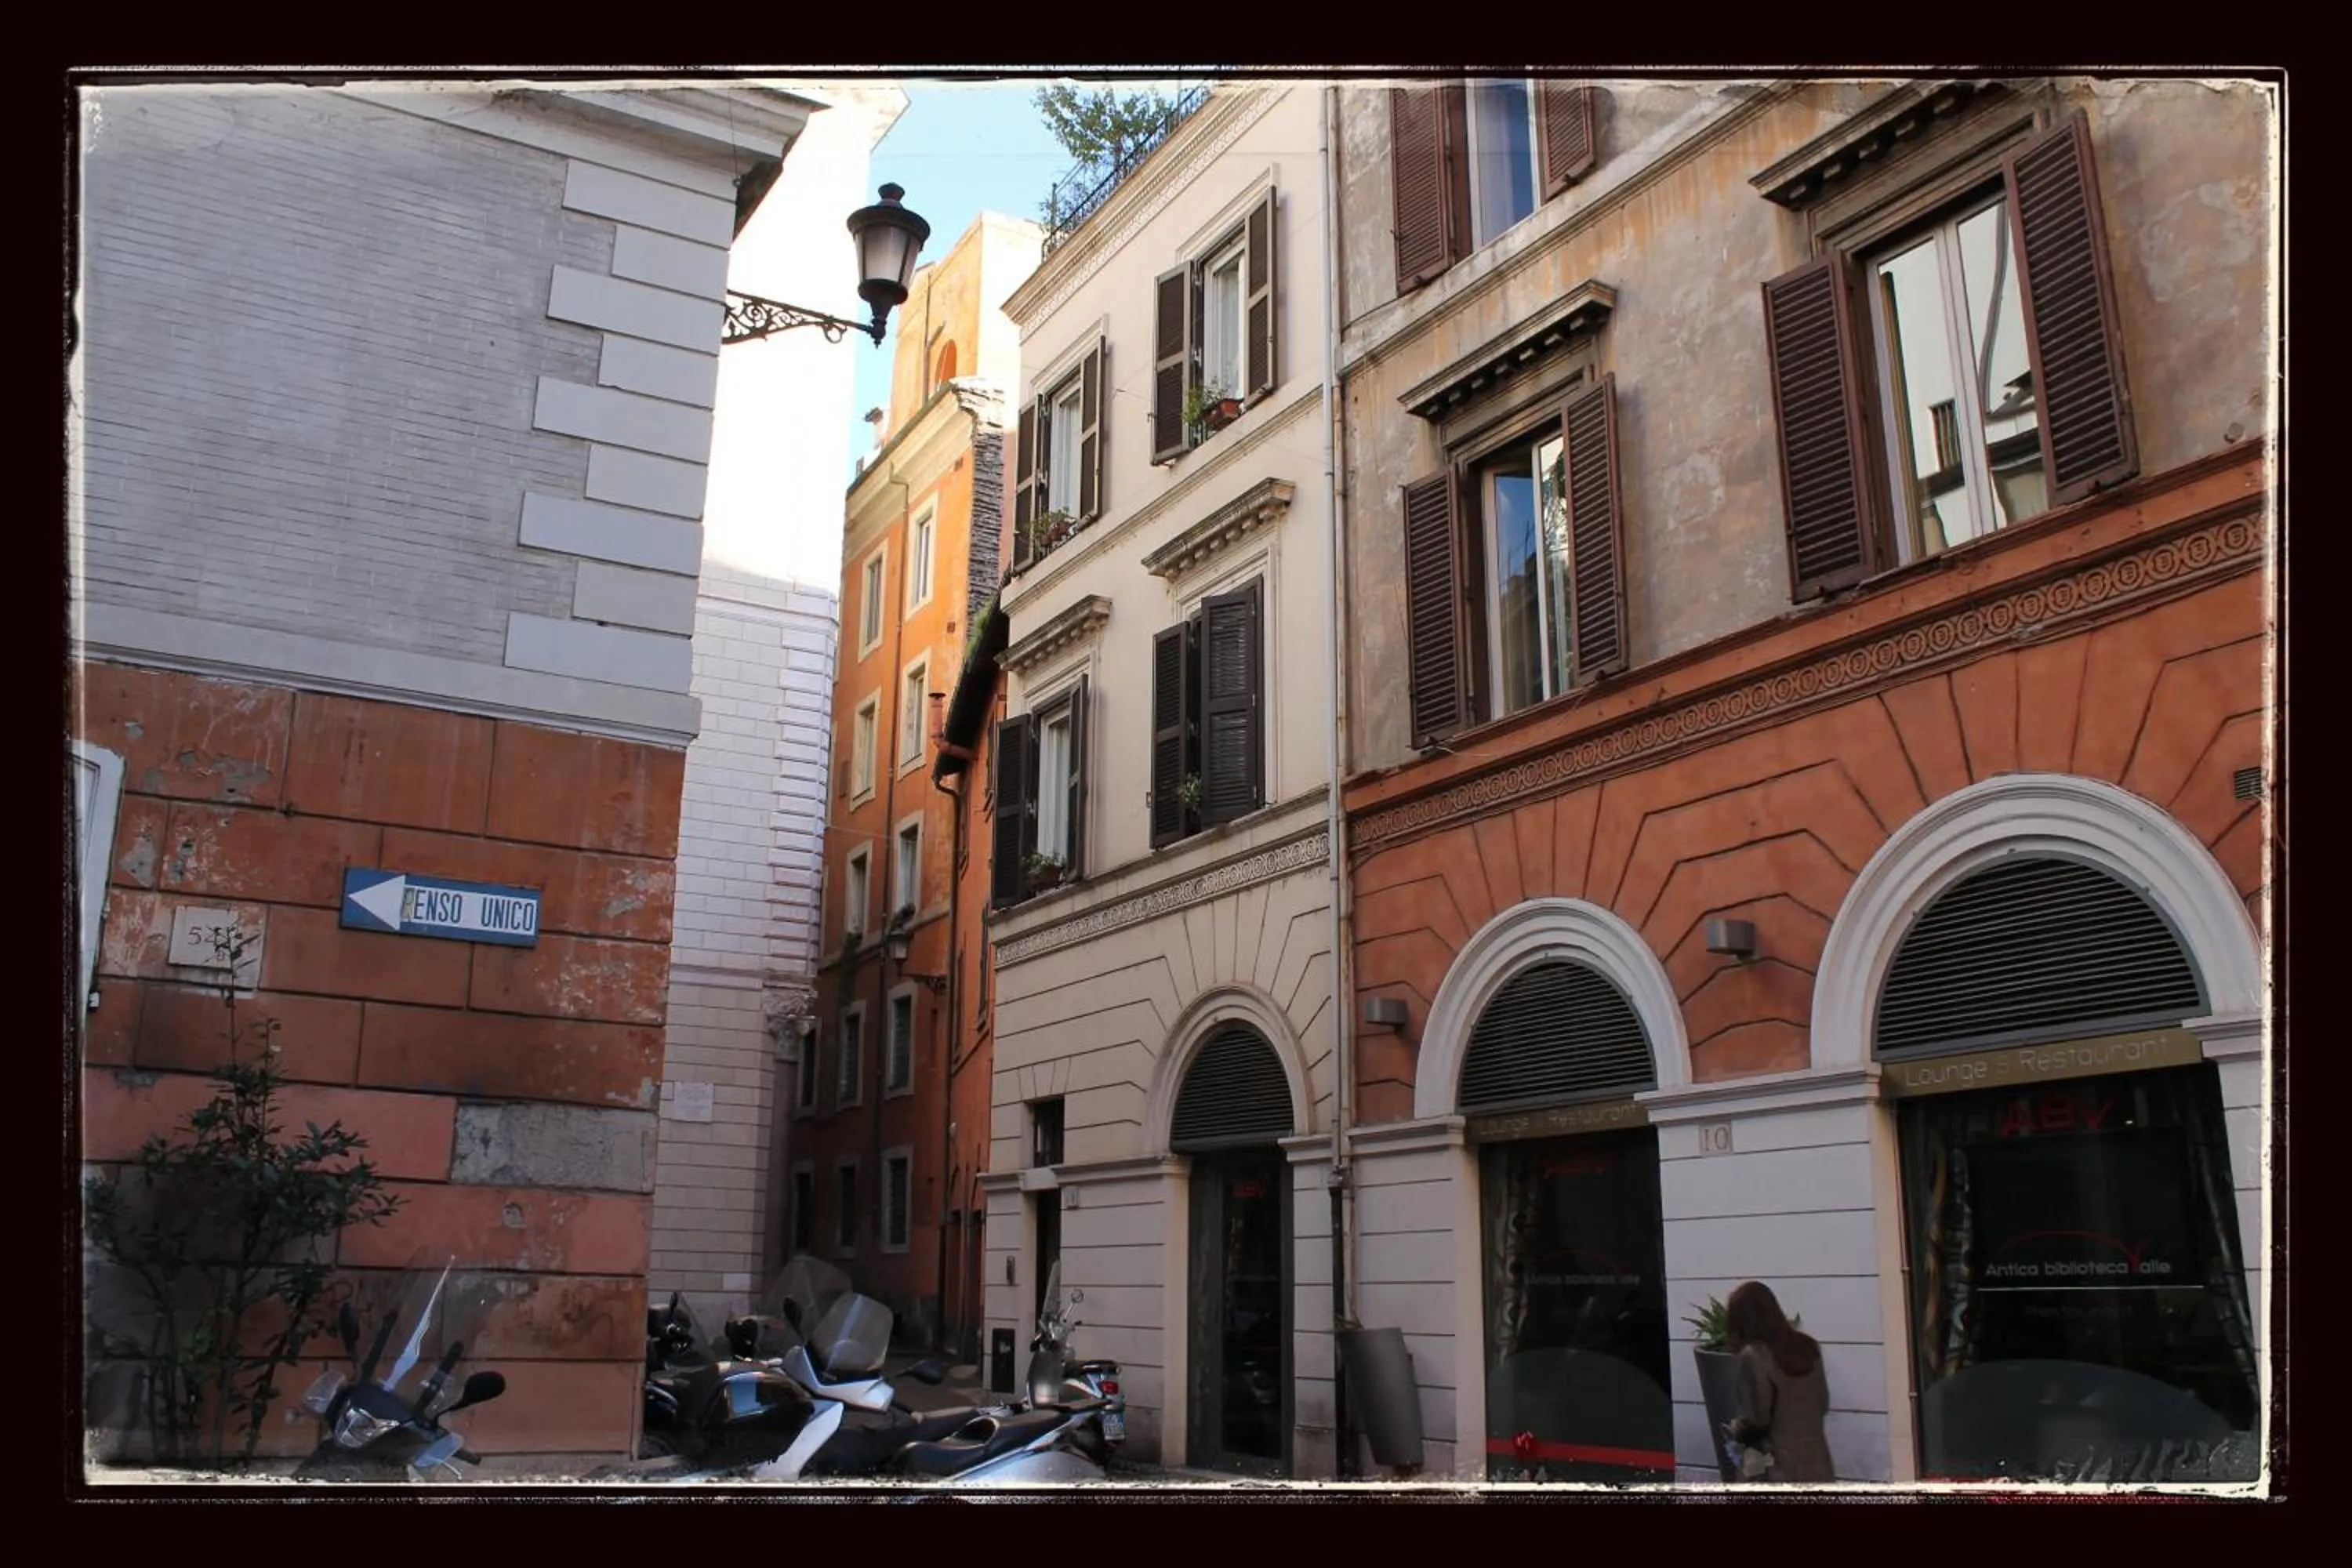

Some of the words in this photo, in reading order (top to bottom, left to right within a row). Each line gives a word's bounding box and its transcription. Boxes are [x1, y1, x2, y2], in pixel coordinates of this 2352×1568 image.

[481, 896, 534, 931] UNICO
[1906, 1060, 1987, 1088] Lounge
[2019, 1037, 2168, 1073] Restaurant
[2001, 1091, 2118, 1136] ABV
[1704, 1127, 1730, 1152] 10
[1984, 1261, 2038, 1277] Antica
[2044, 1259, 2128, 1276] biblioteca
